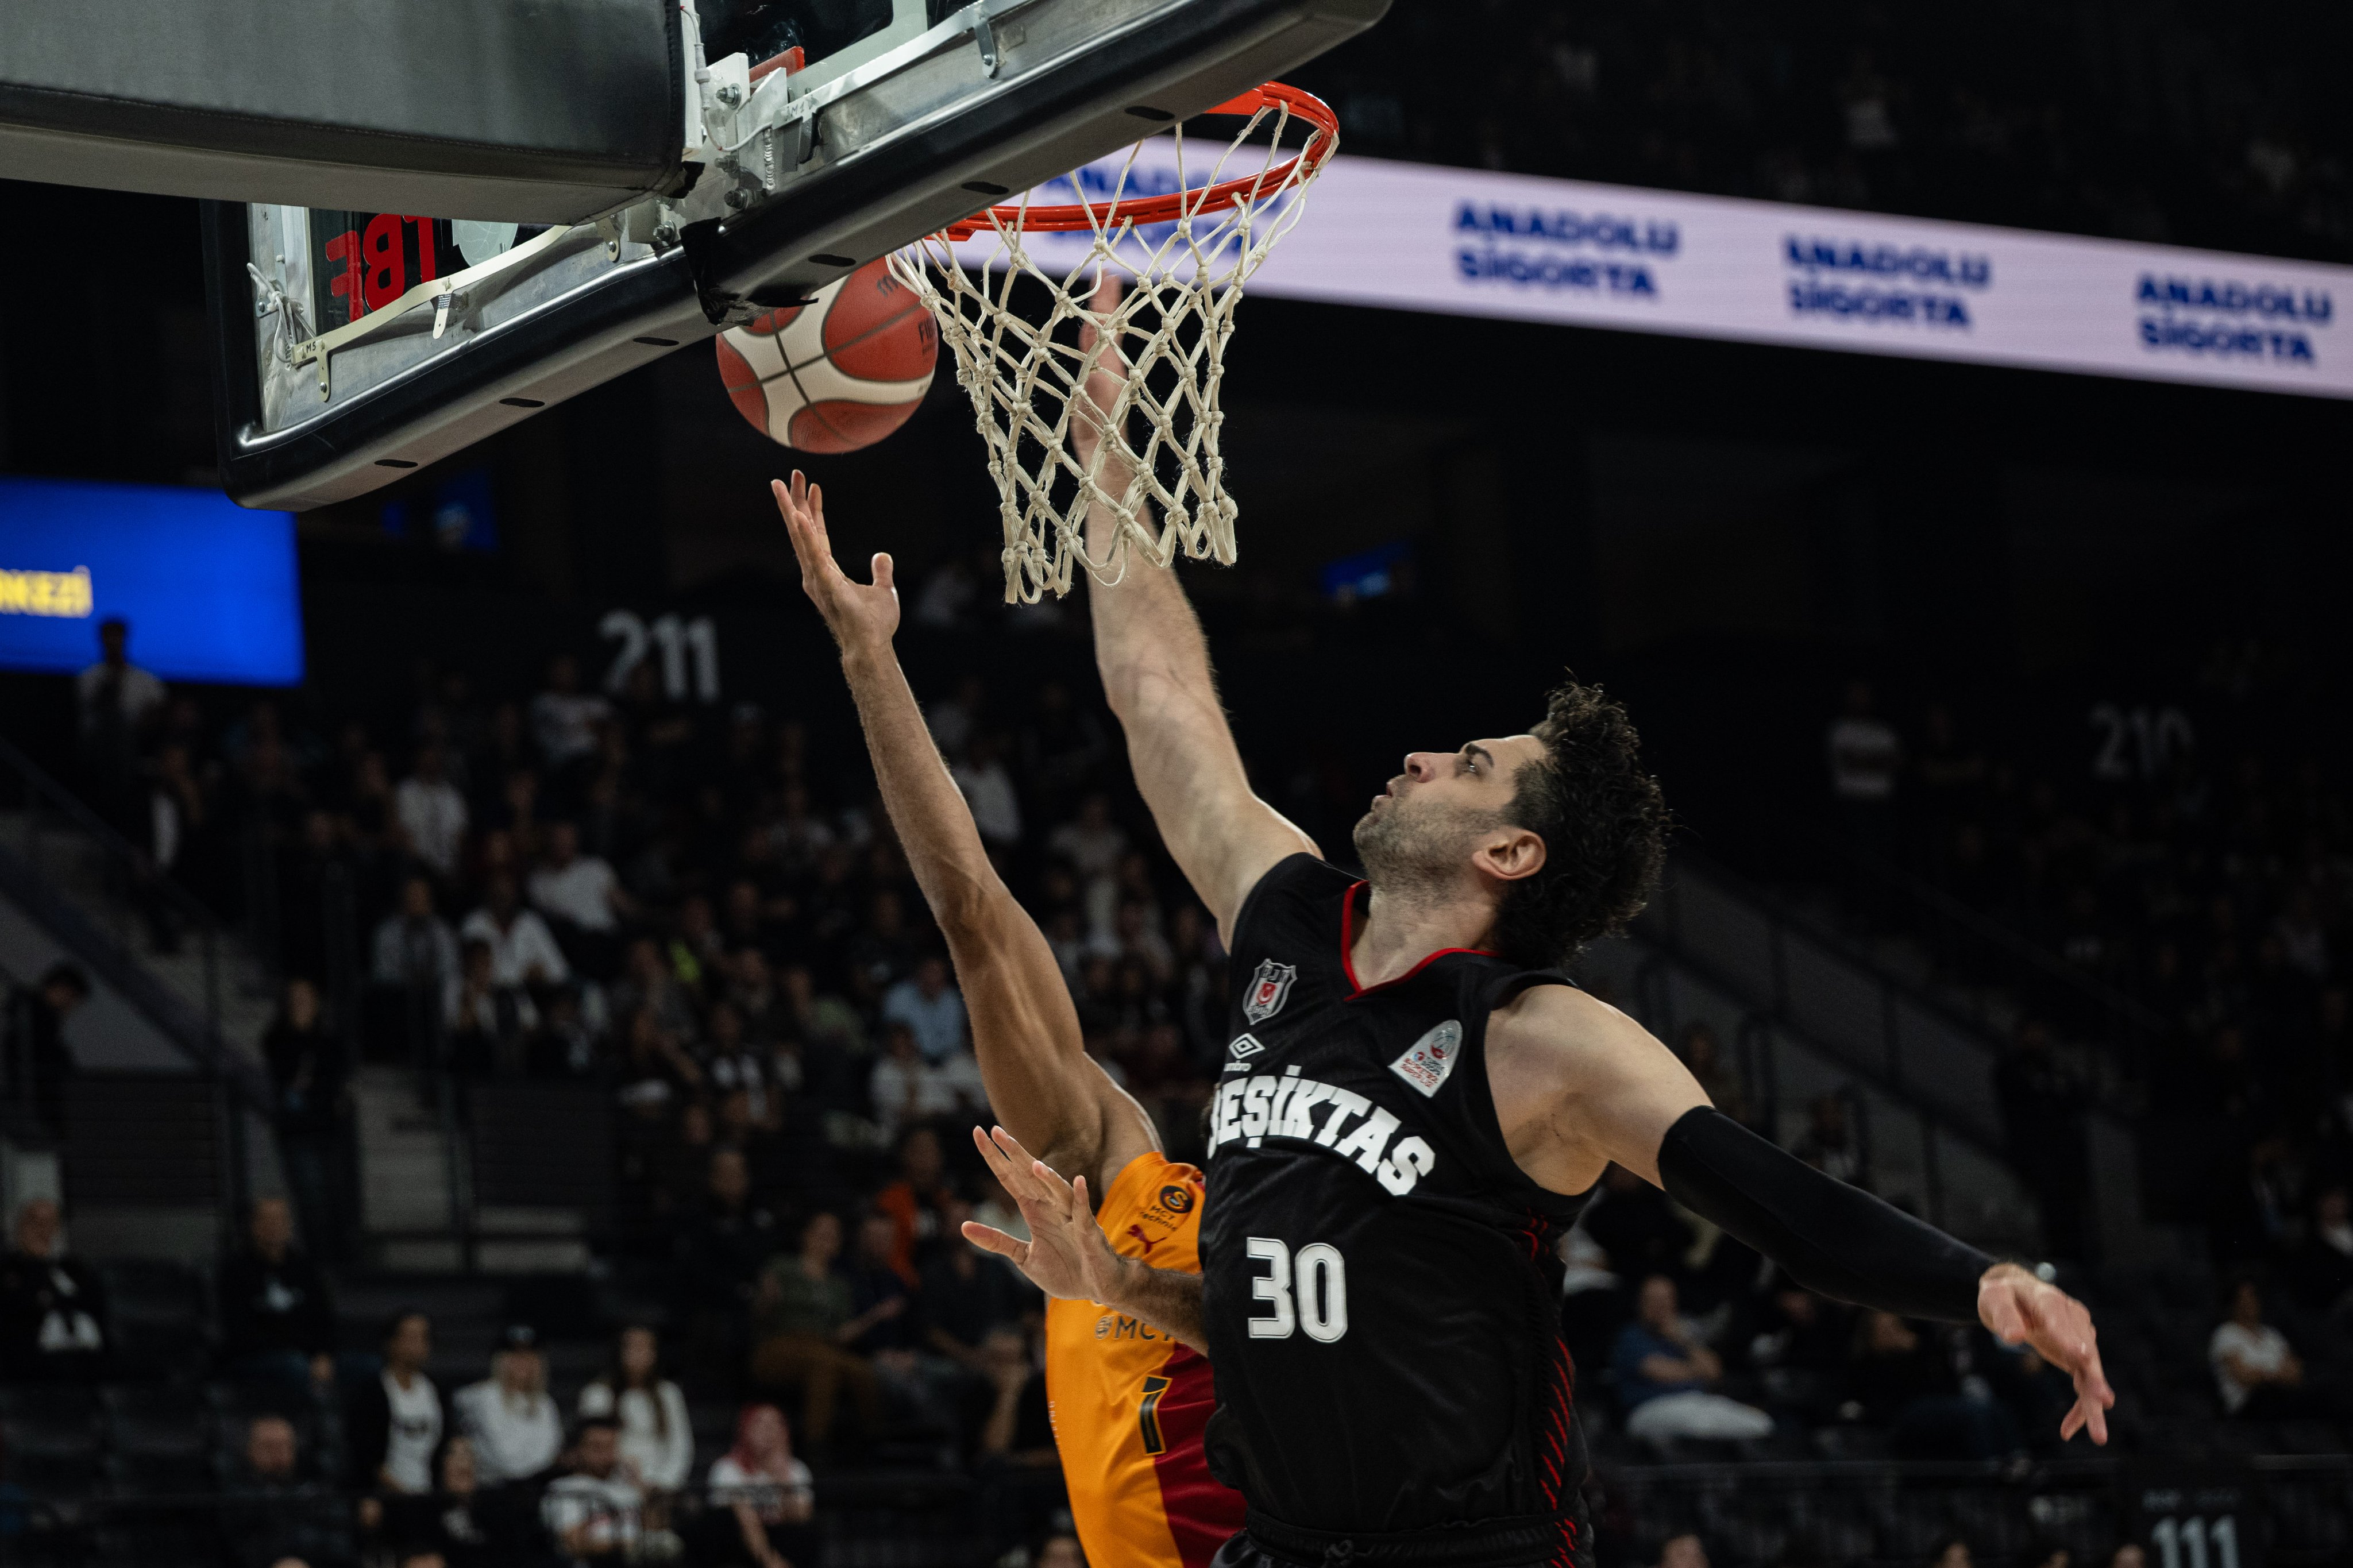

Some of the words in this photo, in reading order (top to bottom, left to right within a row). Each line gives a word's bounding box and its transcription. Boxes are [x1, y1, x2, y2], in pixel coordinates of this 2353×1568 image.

[1455, 199, 1679, 257] ANADOLU
[1784, 237, 1992, 290] ANADOLU
[2136, 271, 2335, 327] ANADOLU
[306, 341, 317, 354] M5
[601, 610, 719, 700] 211
[1247, 1236, 1348, 1343] 30
[1114, 1315, 1172, 1342] MC
[2152, 1516, 2241, 1568] 111
